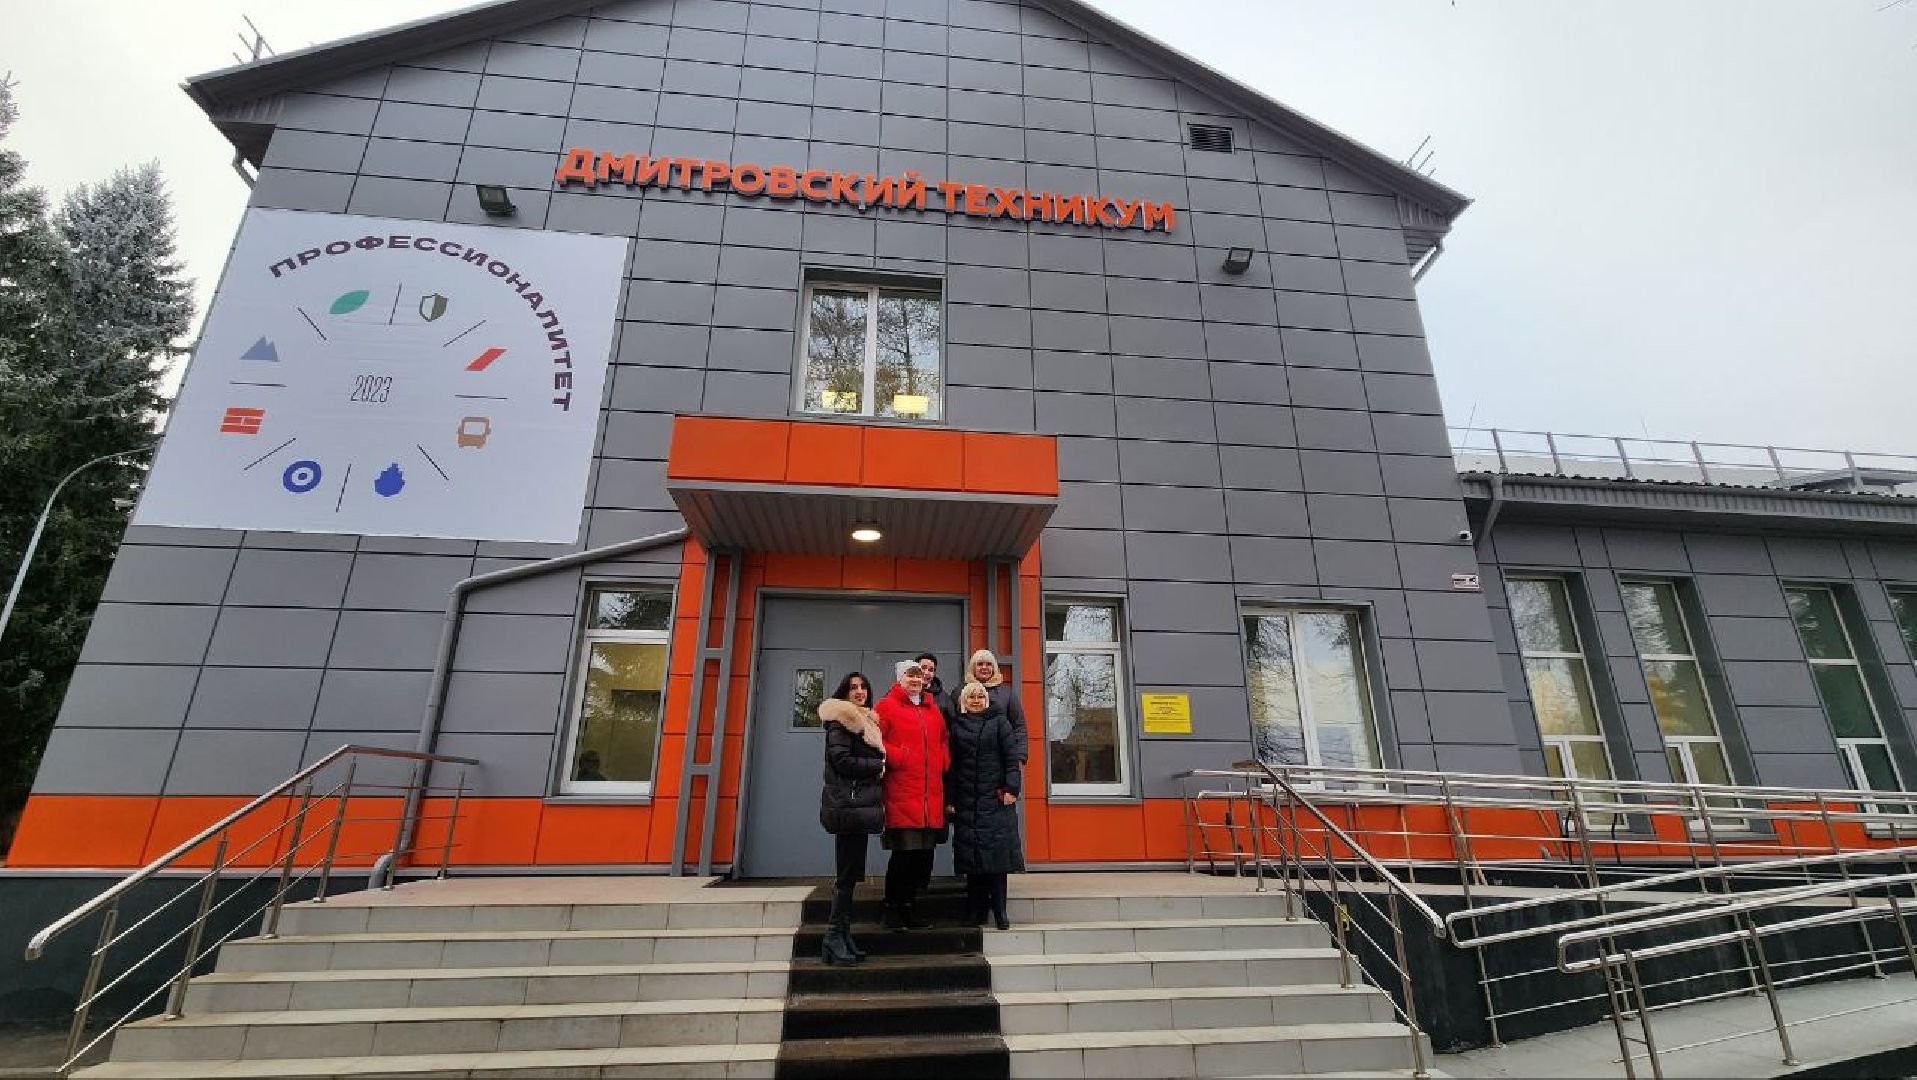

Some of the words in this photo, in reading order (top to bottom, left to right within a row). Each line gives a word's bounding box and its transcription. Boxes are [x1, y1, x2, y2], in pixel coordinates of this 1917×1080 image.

[555, 148, 926, 211] ДМИТРОВСКИЙ
[937, 181, 1175, 232] ТЕХНИКУМ
[269, 235, 573, 412] ПРОФЕССИОНАЛИТЕТ
[350, 374, 393, 403] 2023
